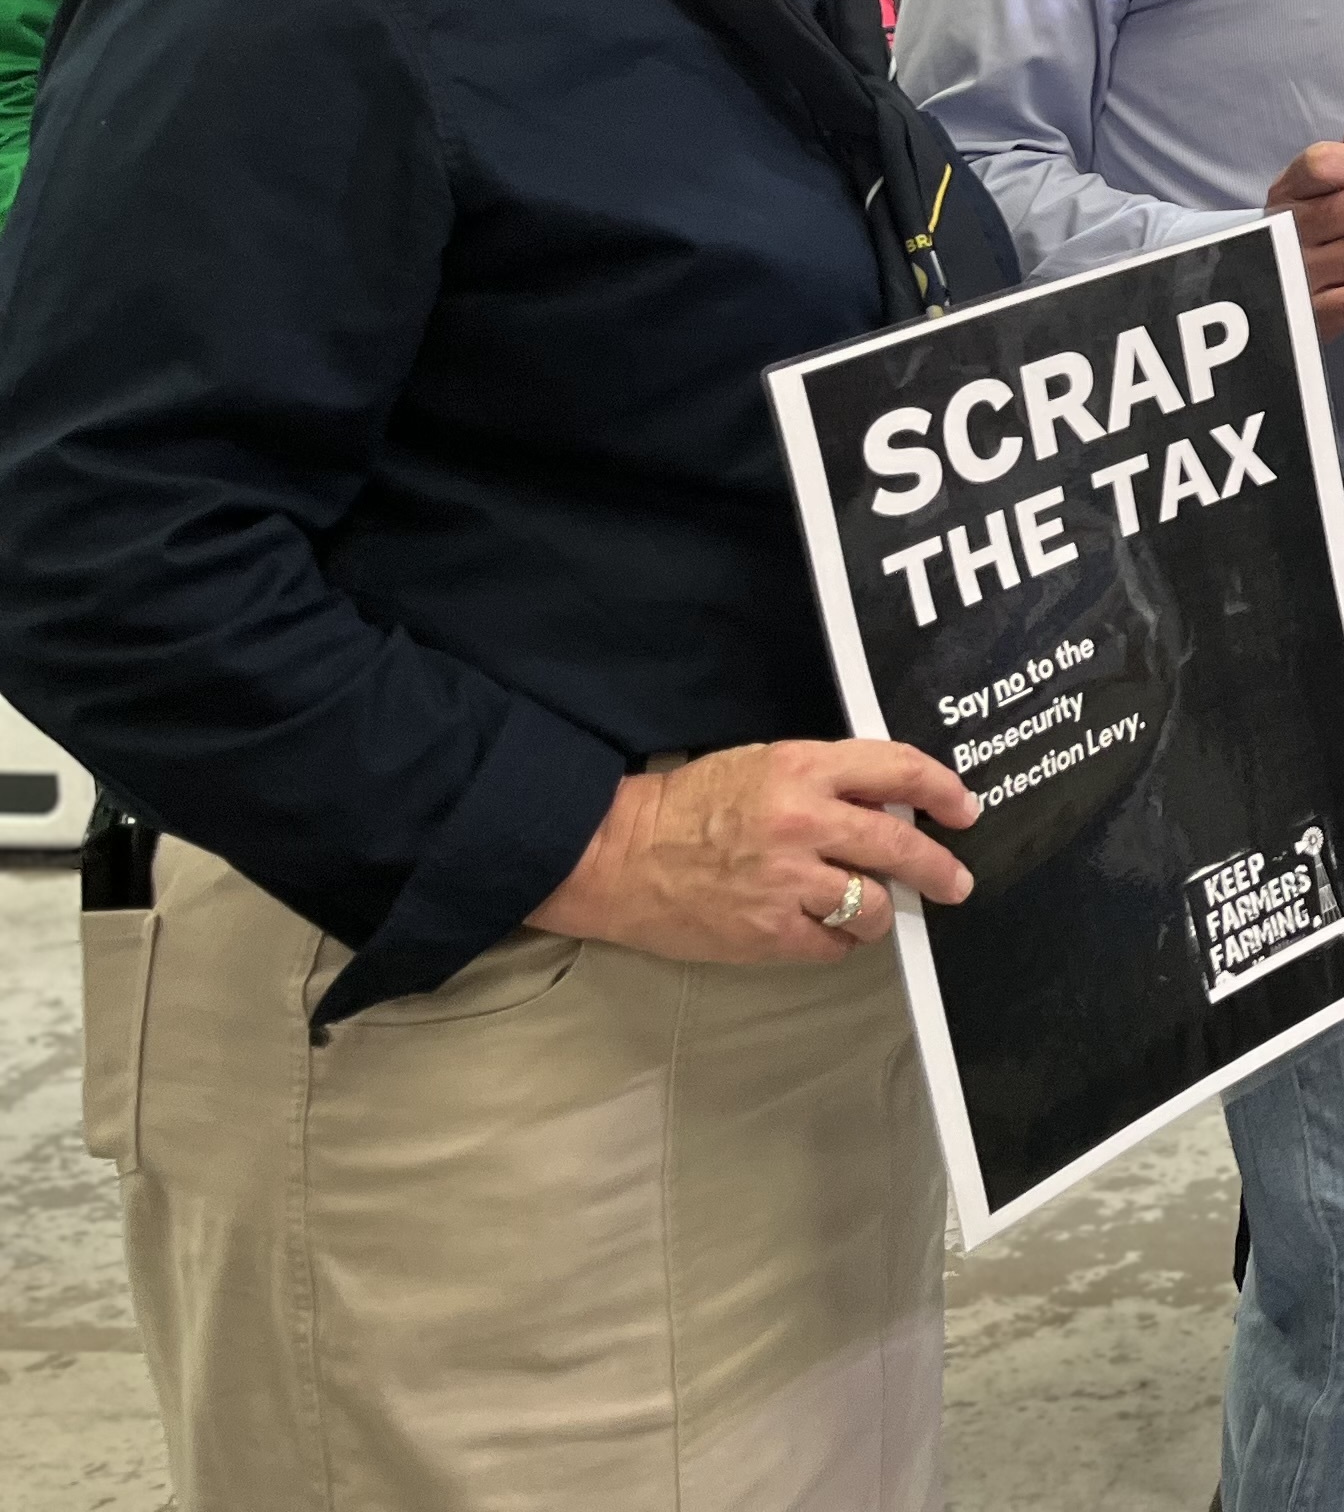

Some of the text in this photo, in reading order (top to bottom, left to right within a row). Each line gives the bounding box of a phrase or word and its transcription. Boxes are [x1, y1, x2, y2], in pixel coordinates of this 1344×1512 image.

[862, 299, 1251, 518] SCRAP
[882, 411, 1278, 628] THE TAX
[938, 638, 1095, 726] Say no to the
[952, 692, 1083, 774] Biosecurity
[977, 712, 1147, 813] rotection Levy.
[1203, 852, 1266, 907] KEEP
[1206, 864, 1312, 942] FARMERS
